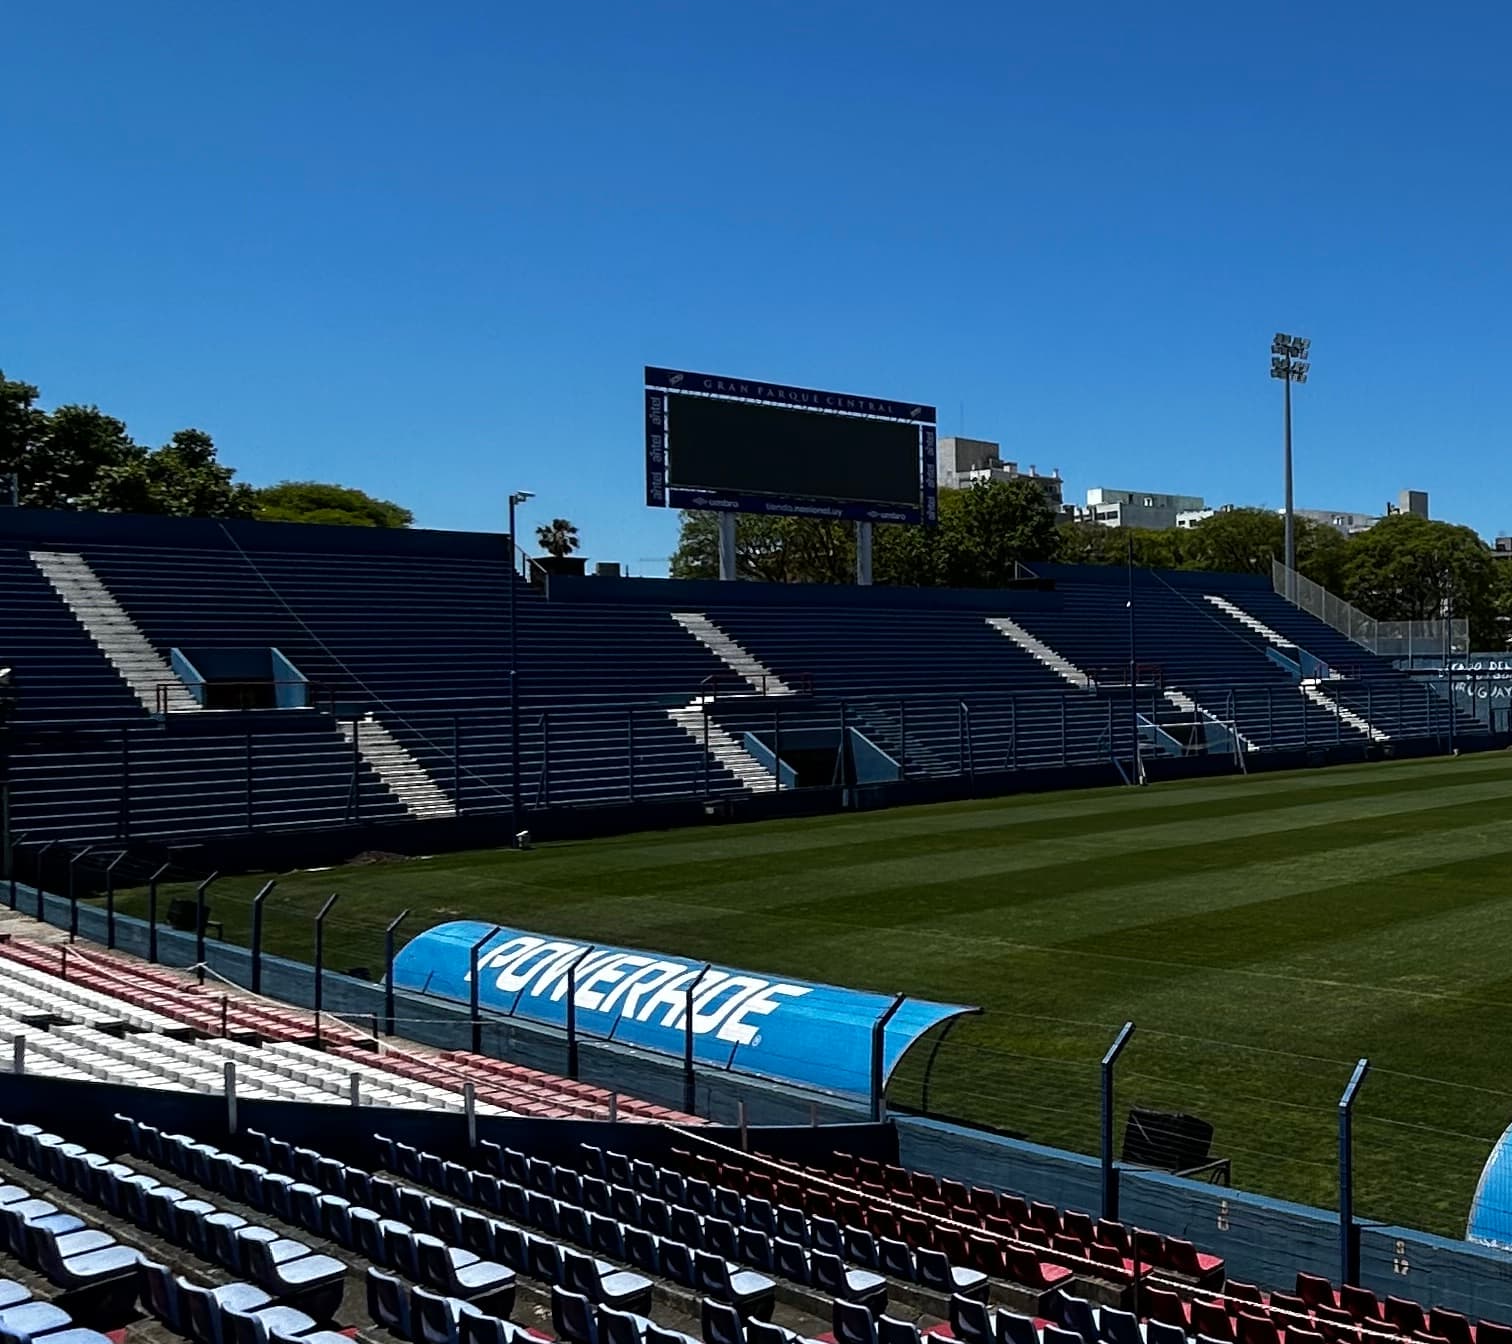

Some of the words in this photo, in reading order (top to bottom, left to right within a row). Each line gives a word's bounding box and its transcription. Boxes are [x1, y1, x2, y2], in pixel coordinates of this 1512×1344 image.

[702, 378, 749, 394] GRAN
[757, 386, 820, 404] PARQUE
[825, 396, 895, 414] CENTRAL
[464, 935, 815, 1046] POWERADE
